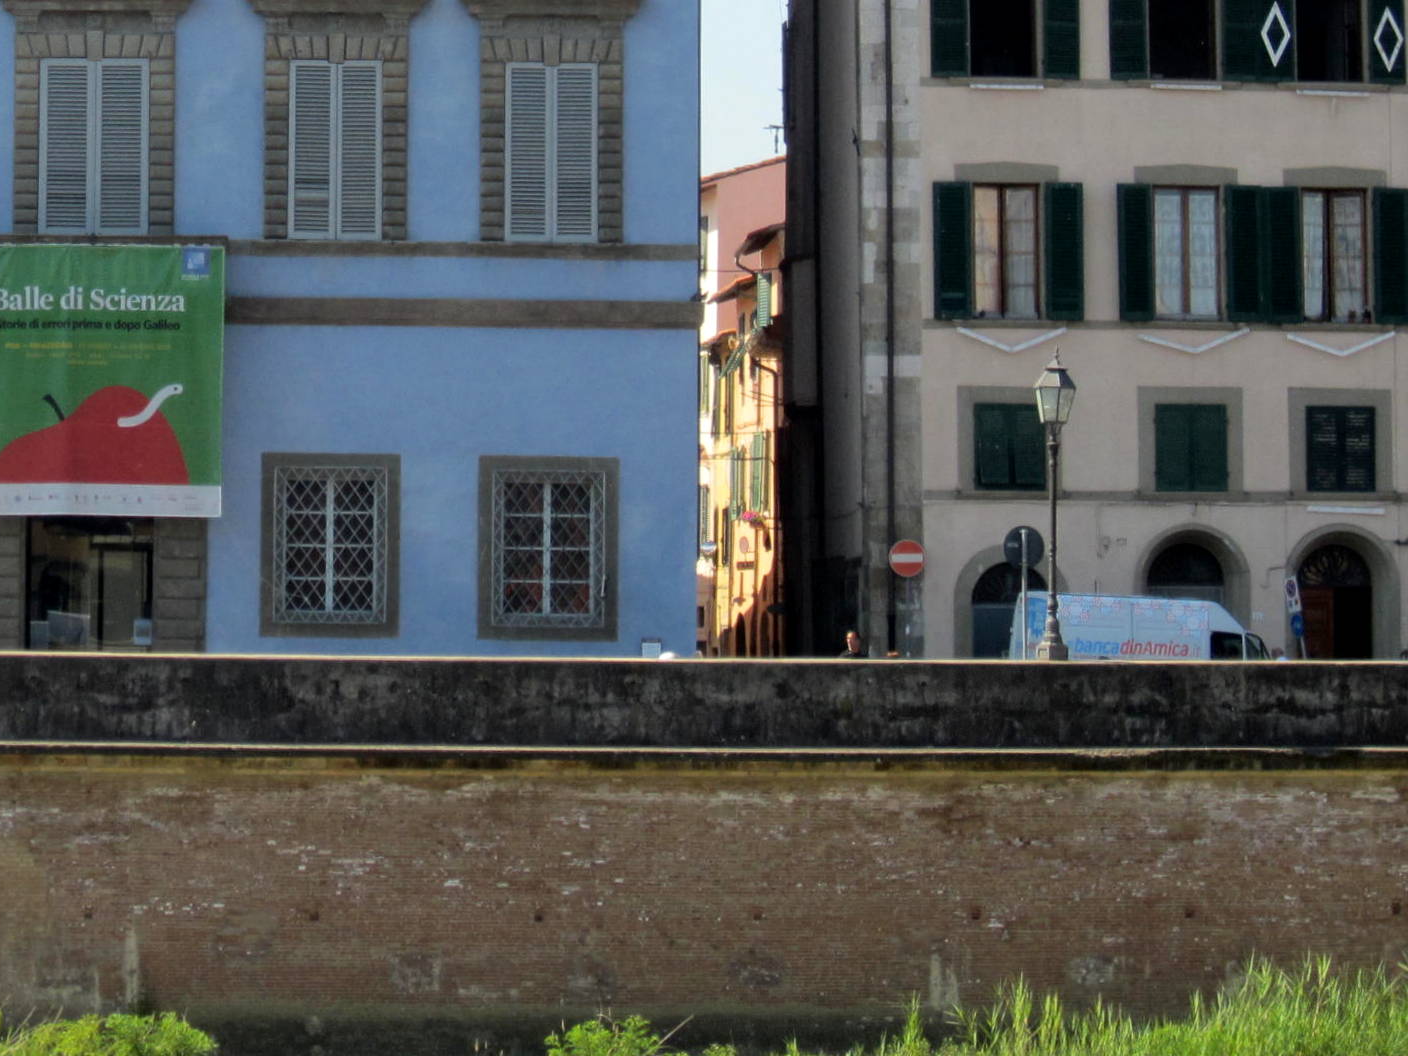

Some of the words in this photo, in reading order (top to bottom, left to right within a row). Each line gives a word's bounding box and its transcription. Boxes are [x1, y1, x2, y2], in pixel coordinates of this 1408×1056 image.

[60, 285, 83, 311] di
[89, 288, 186, 312] Scienza
[29, 318, 39, 330] di
[41, 318, 71, 330] errori
[72, 318, 103, 332] prima
[105, 321, 112, 330] e
[114, 319, 141, 332] dopo
[143, 319, 181, 331] Galileo
